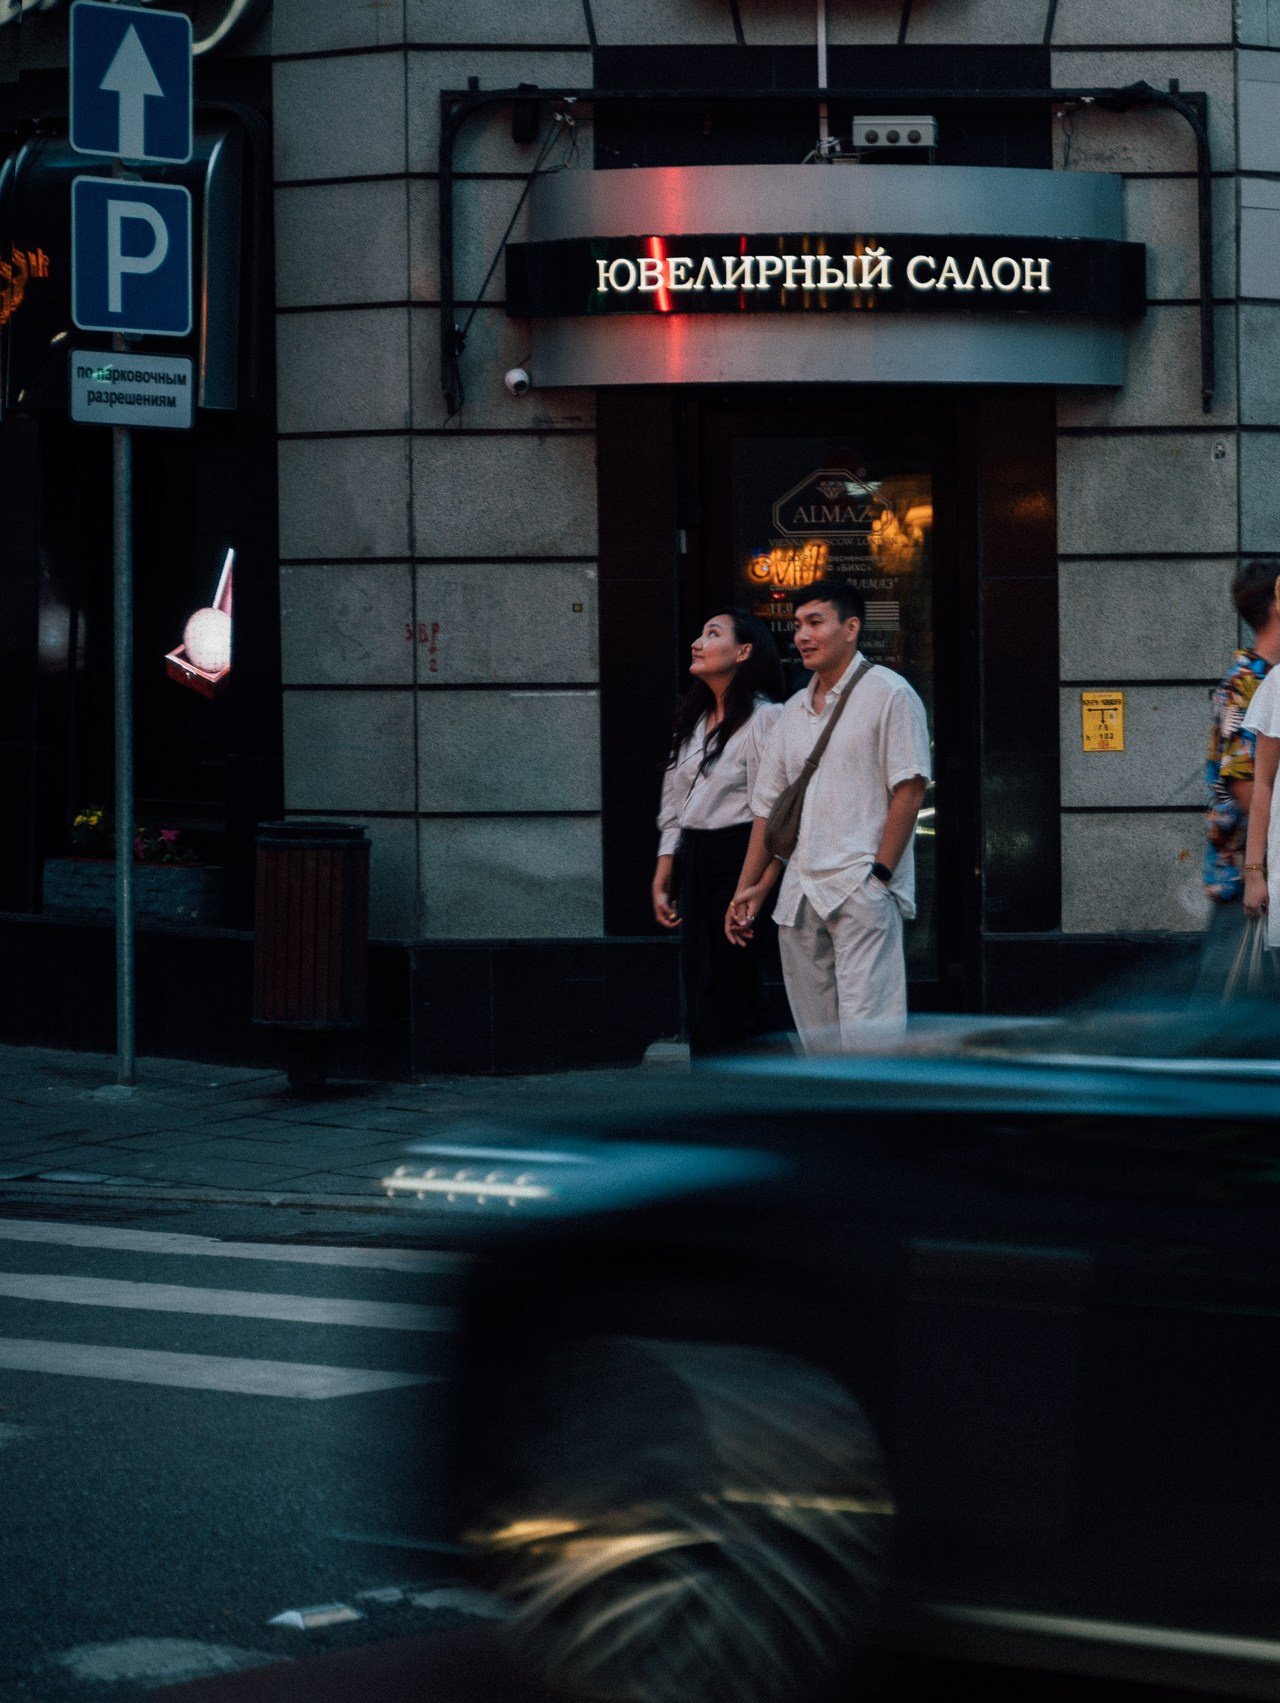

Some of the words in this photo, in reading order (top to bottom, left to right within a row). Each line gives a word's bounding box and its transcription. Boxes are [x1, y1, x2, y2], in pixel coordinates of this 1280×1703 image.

[107, 199, 169, 313] P
[596, 247, 892, 292] ЮВЕЛИРНЫЙ
[905, 254, 1052, 292] САЛОН
[76, 366, 93, 379] по
[96, 367, 187, 386] парковочным
[87, 390, 177, 408] разрешениям
[793, 504, 873, 525] ALMAZ
